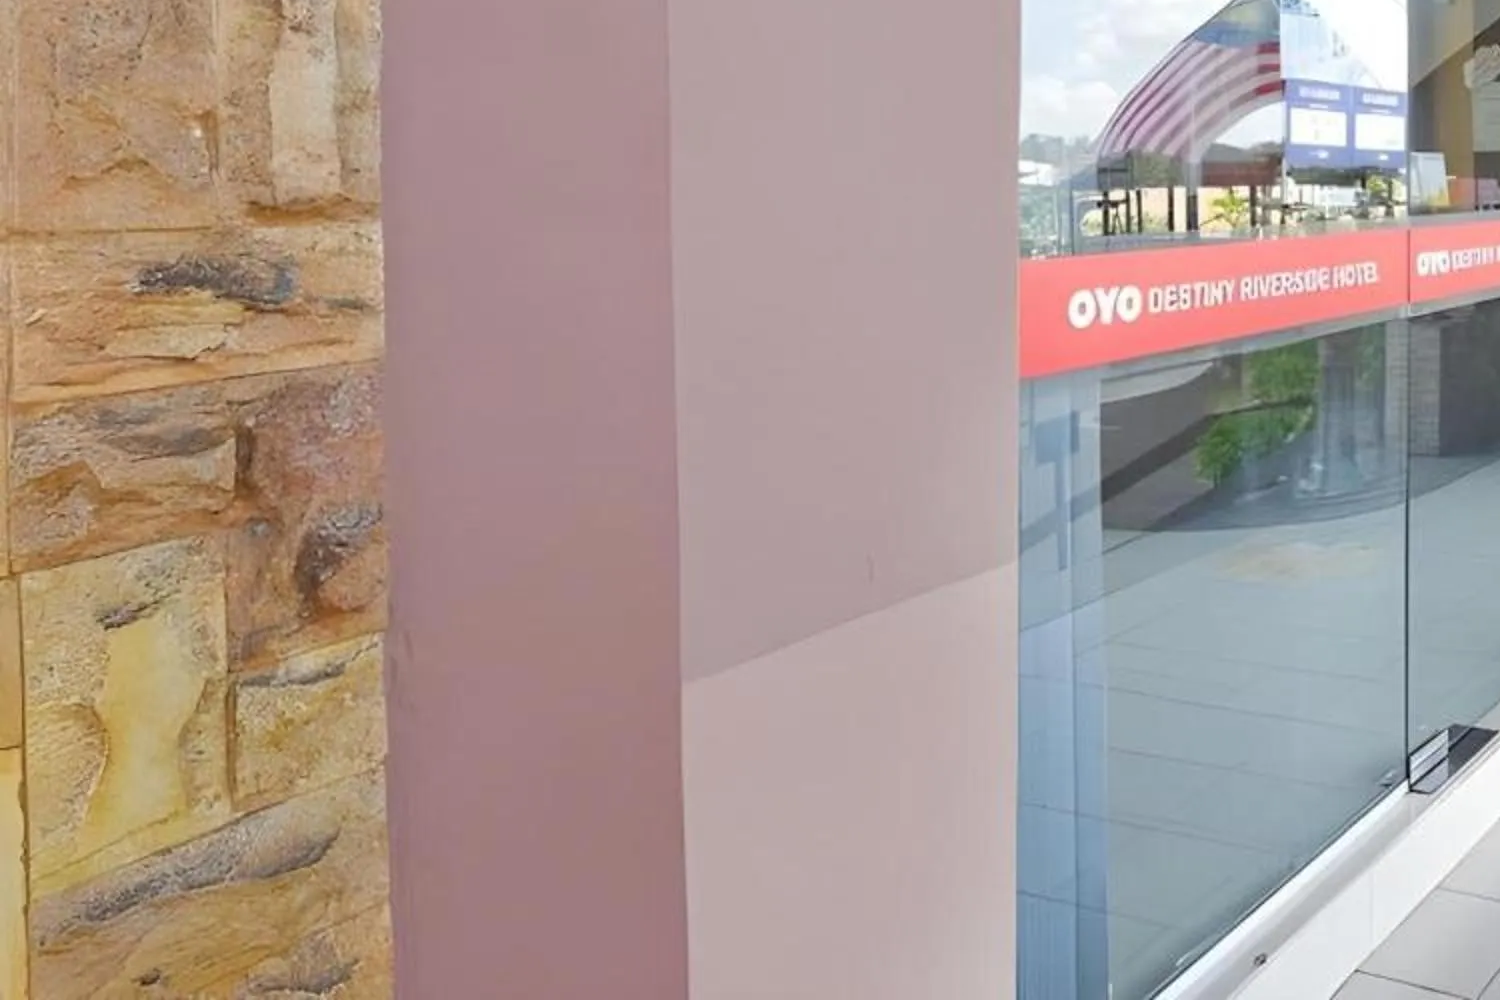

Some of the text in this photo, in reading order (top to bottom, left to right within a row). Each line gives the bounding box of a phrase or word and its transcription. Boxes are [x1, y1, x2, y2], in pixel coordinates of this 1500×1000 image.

[1068, 261, 1379, 328] OYO DESTINY RIVERSIDE HOTEL
